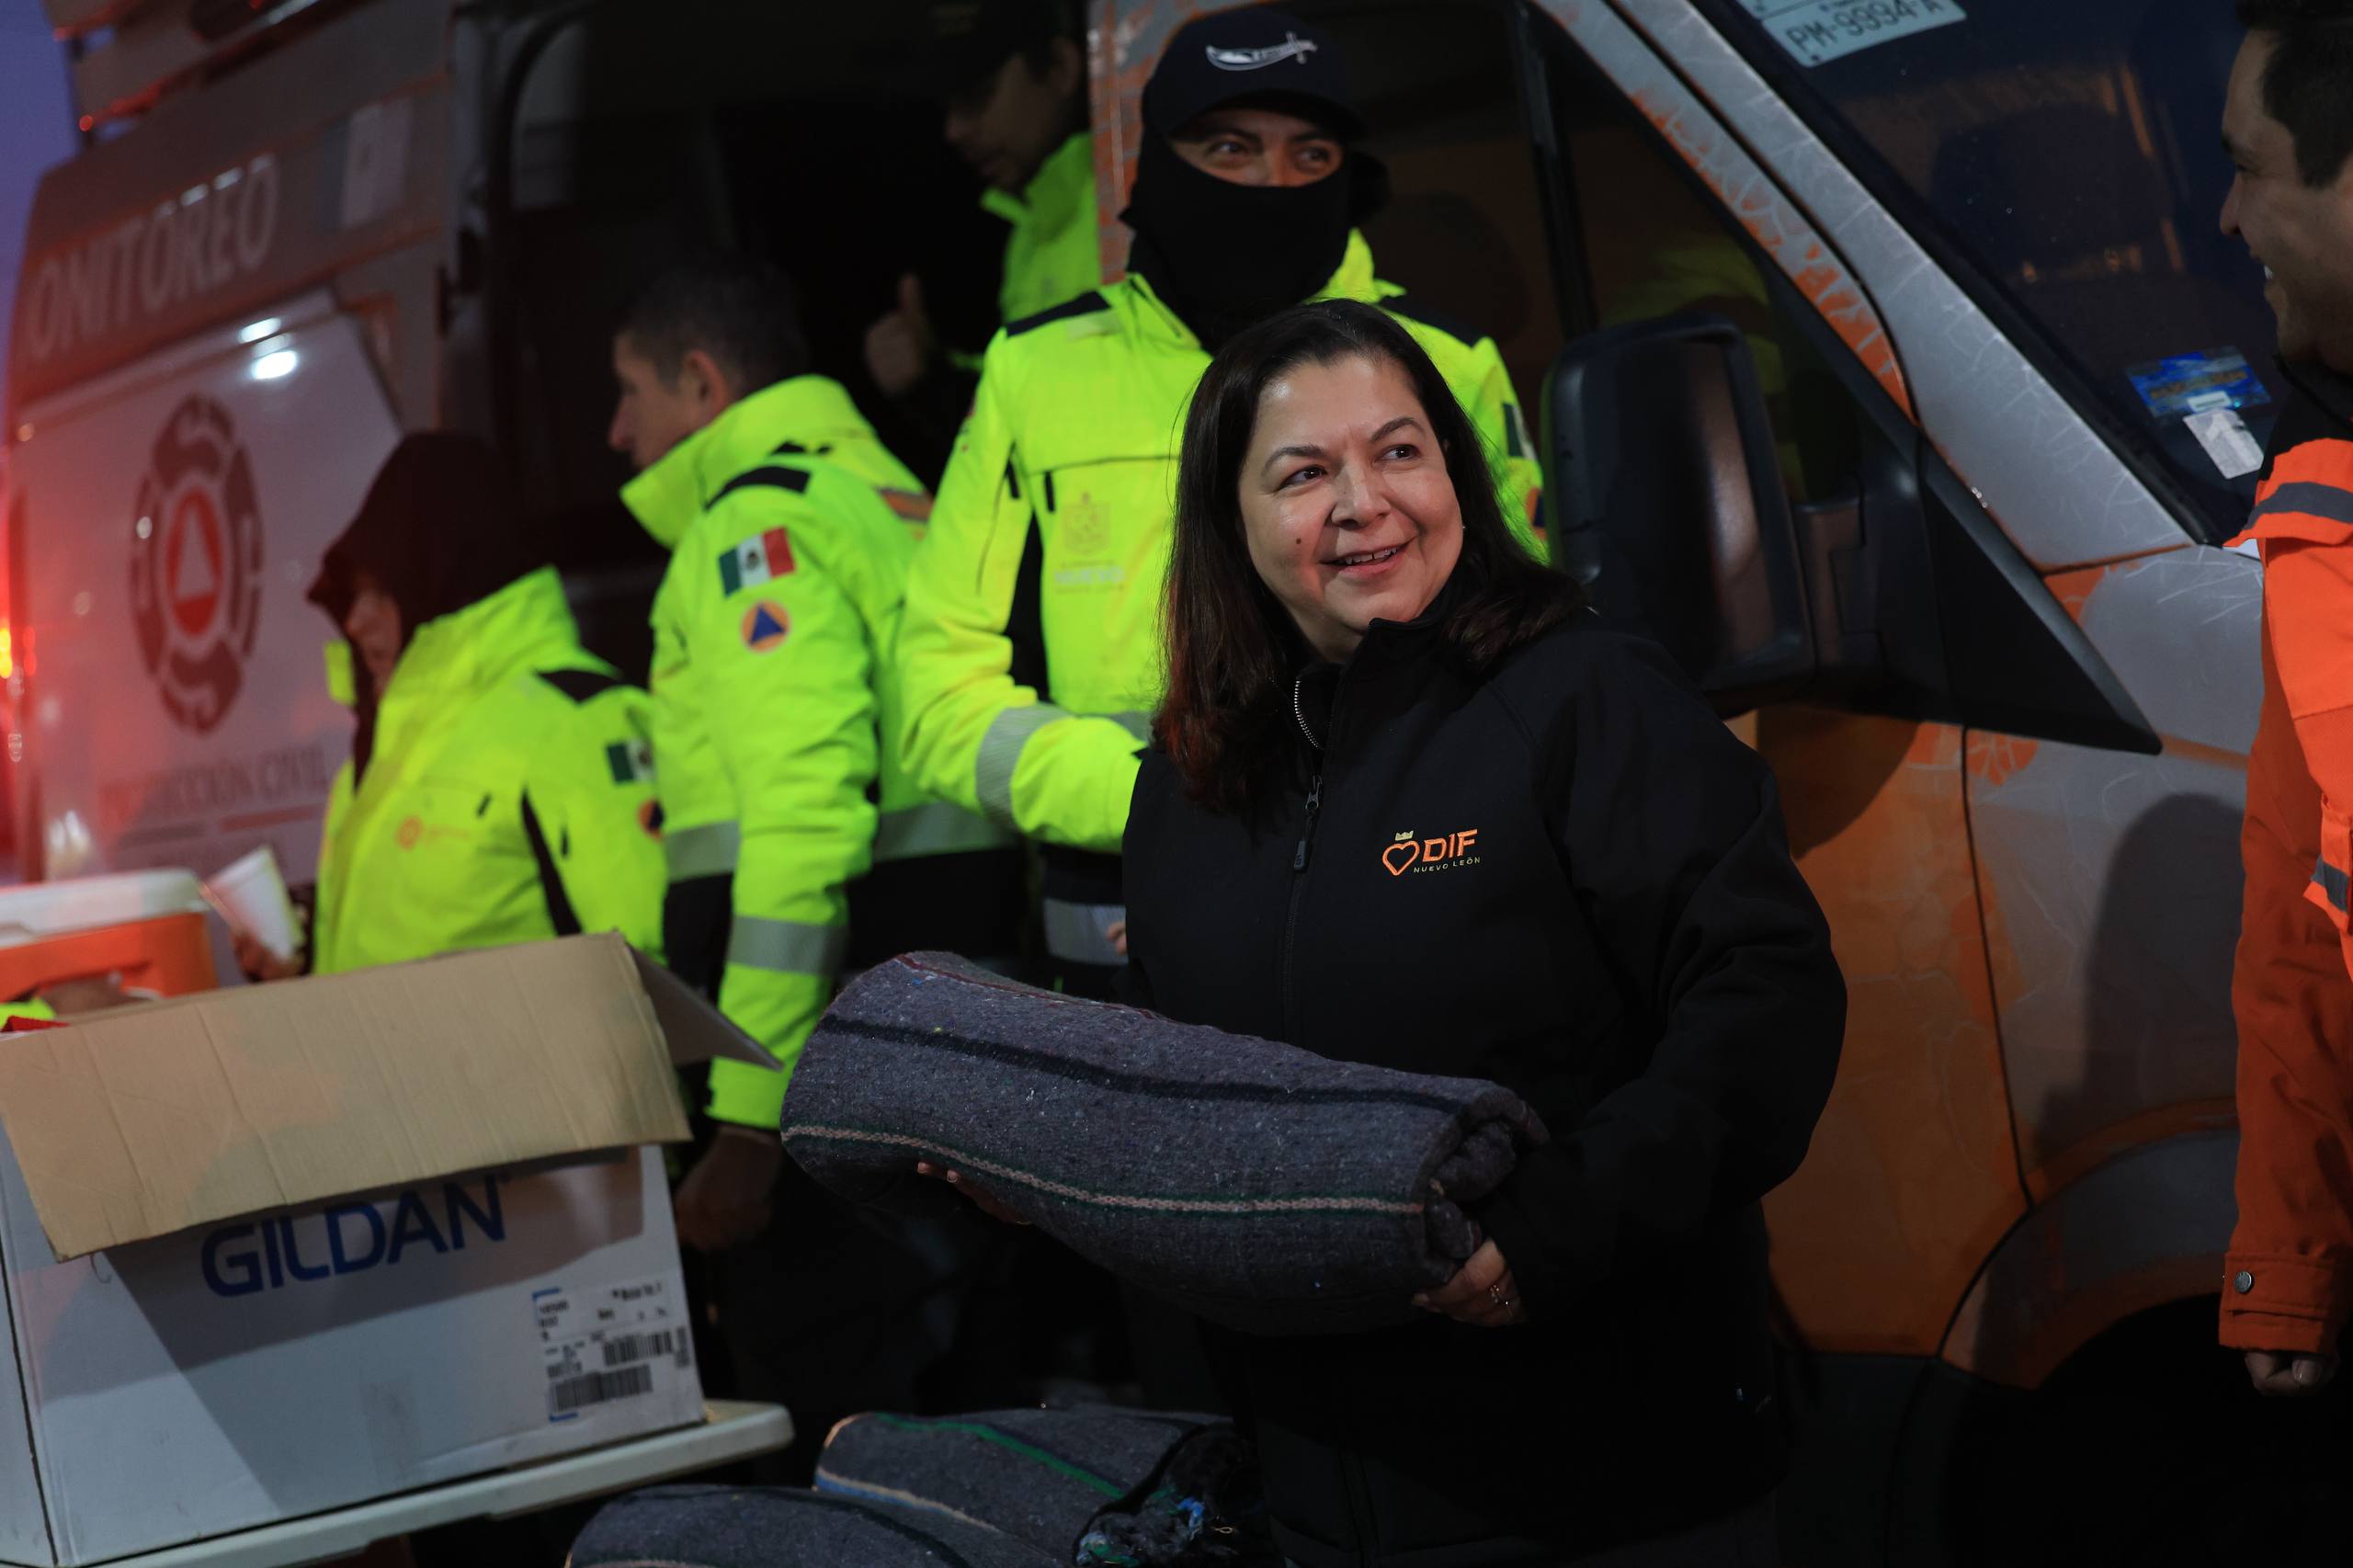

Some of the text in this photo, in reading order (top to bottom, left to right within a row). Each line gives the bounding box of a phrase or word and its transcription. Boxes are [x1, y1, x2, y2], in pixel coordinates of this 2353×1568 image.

[1422, 828, 1478, 862] DIF
[1413, 857, 1481, 874] NUEVO LEÓN
[199, 1176, 506, 1297] GILDAN
